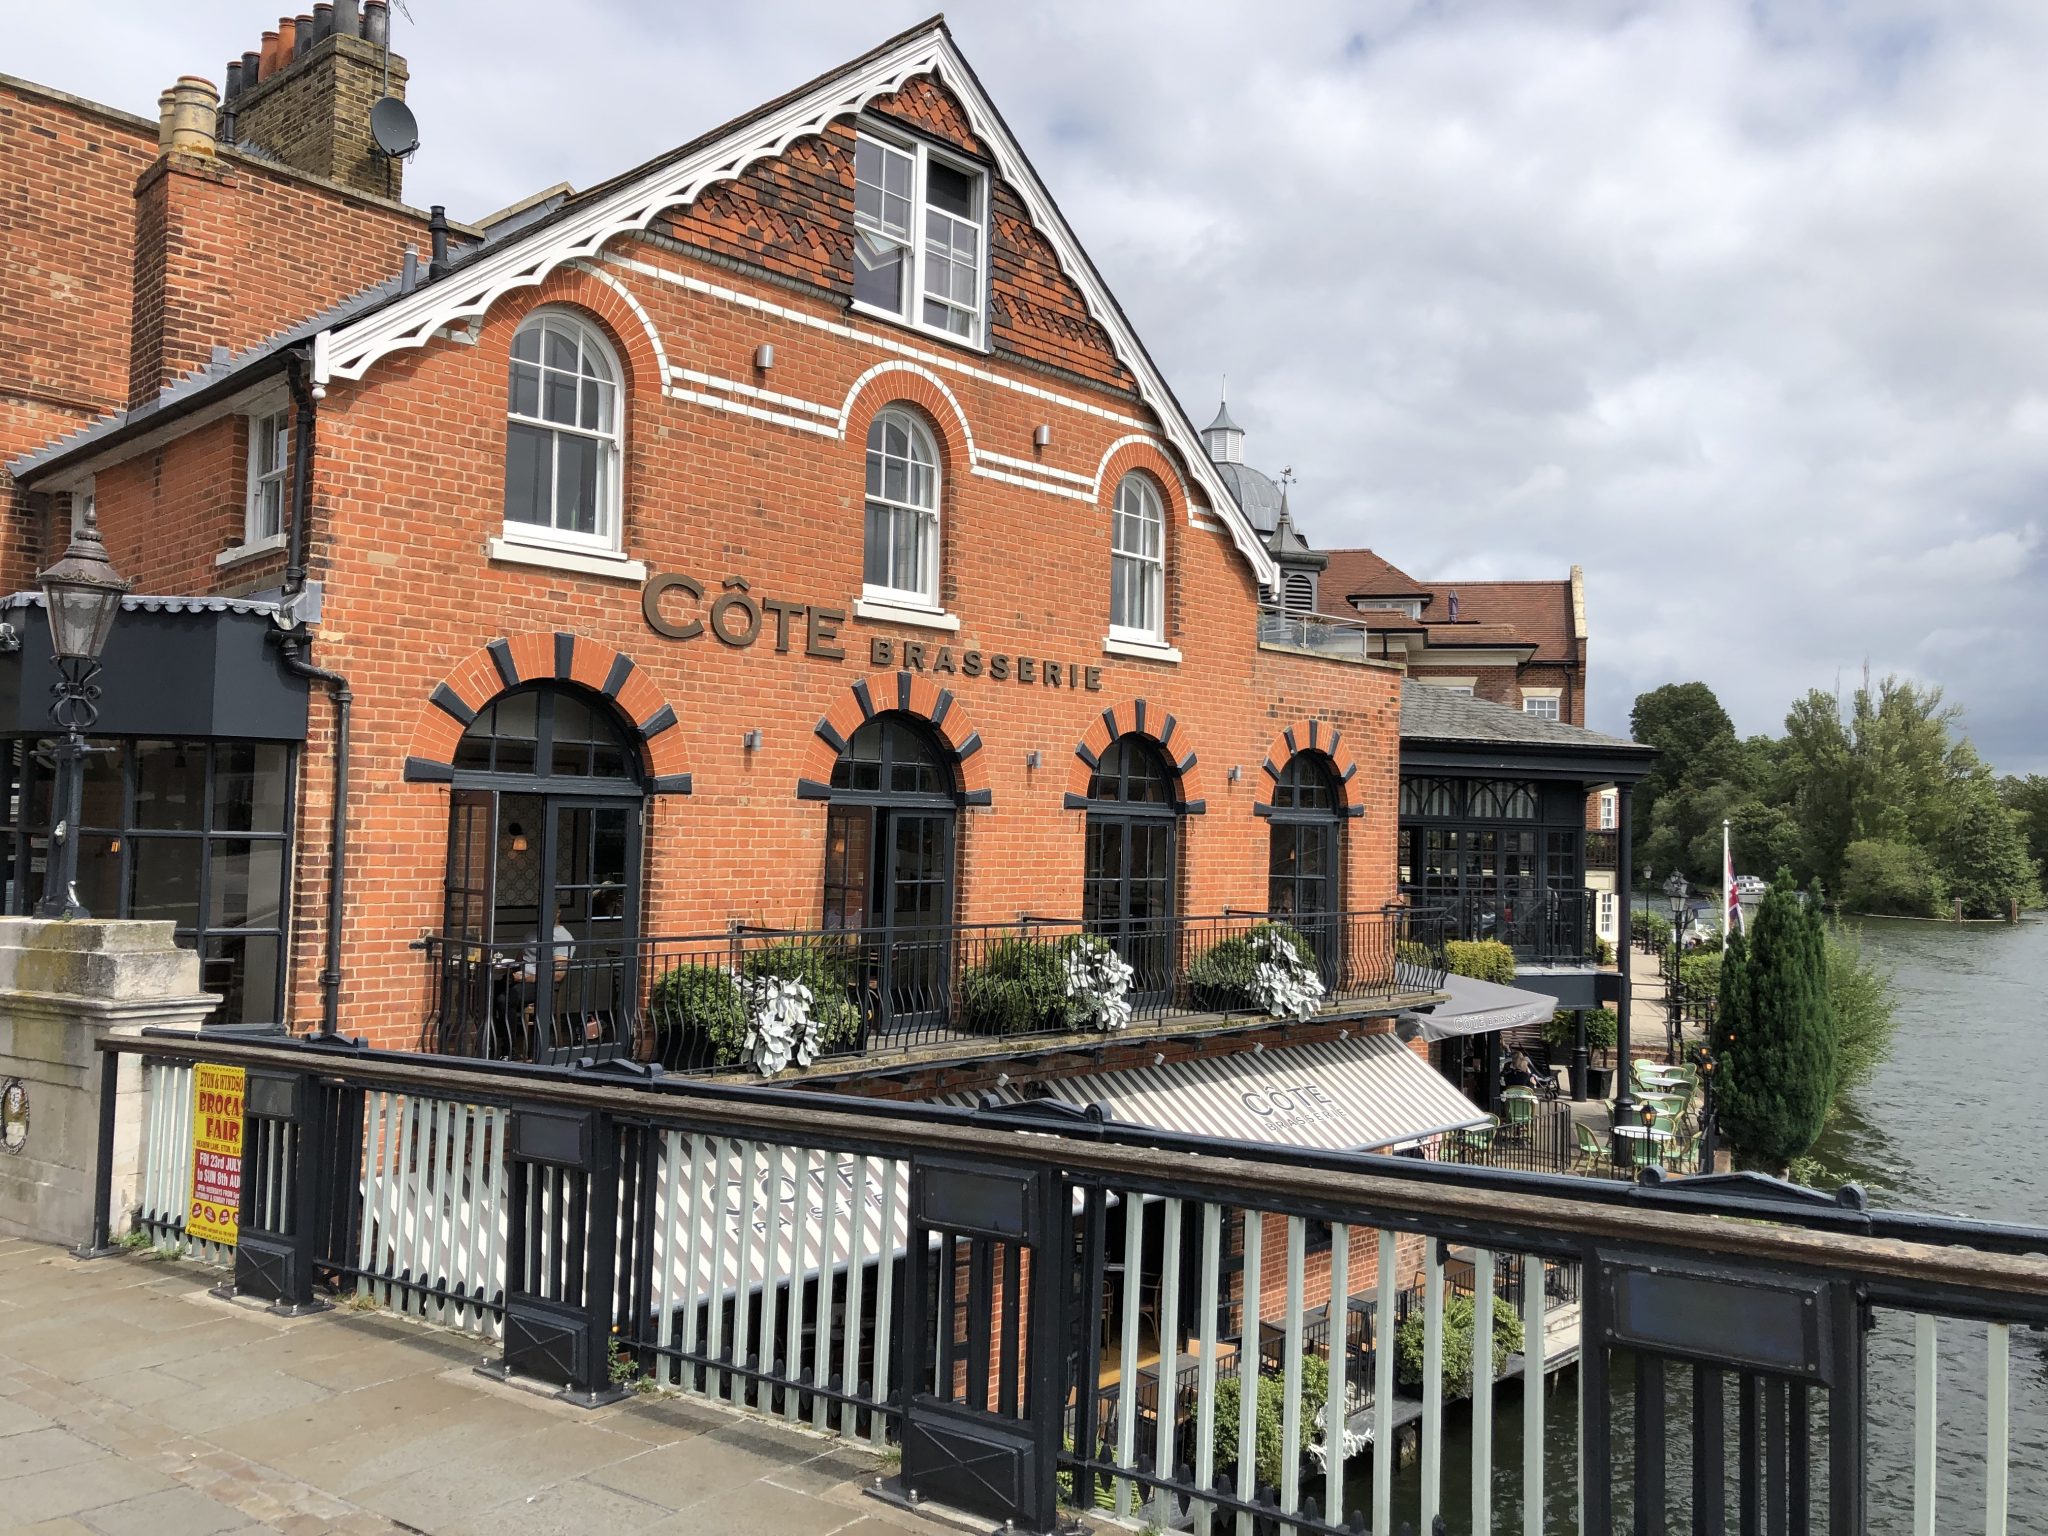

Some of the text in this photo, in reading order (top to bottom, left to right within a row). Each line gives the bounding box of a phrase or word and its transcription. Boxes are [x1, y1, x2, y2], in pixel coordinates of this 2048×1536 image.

[642, 573, 1103, 691] CÔTE BRASSERIE
[200, 1072, 244, 1092] ETON & WINDSO
[1241, 1086, 1332, 1116] CÔTE
[206, 1117, 240, 1143] FAIR
[1265, 1108, 1347, 1131] BRASSERIE
[200, 1152, 241, 1172] FRI 23rd JULY
[204, 1169, 216, 1184] SUN
[217, 1171, 228, 1186] 8th
[229, 1174, 240, 1188] AU
